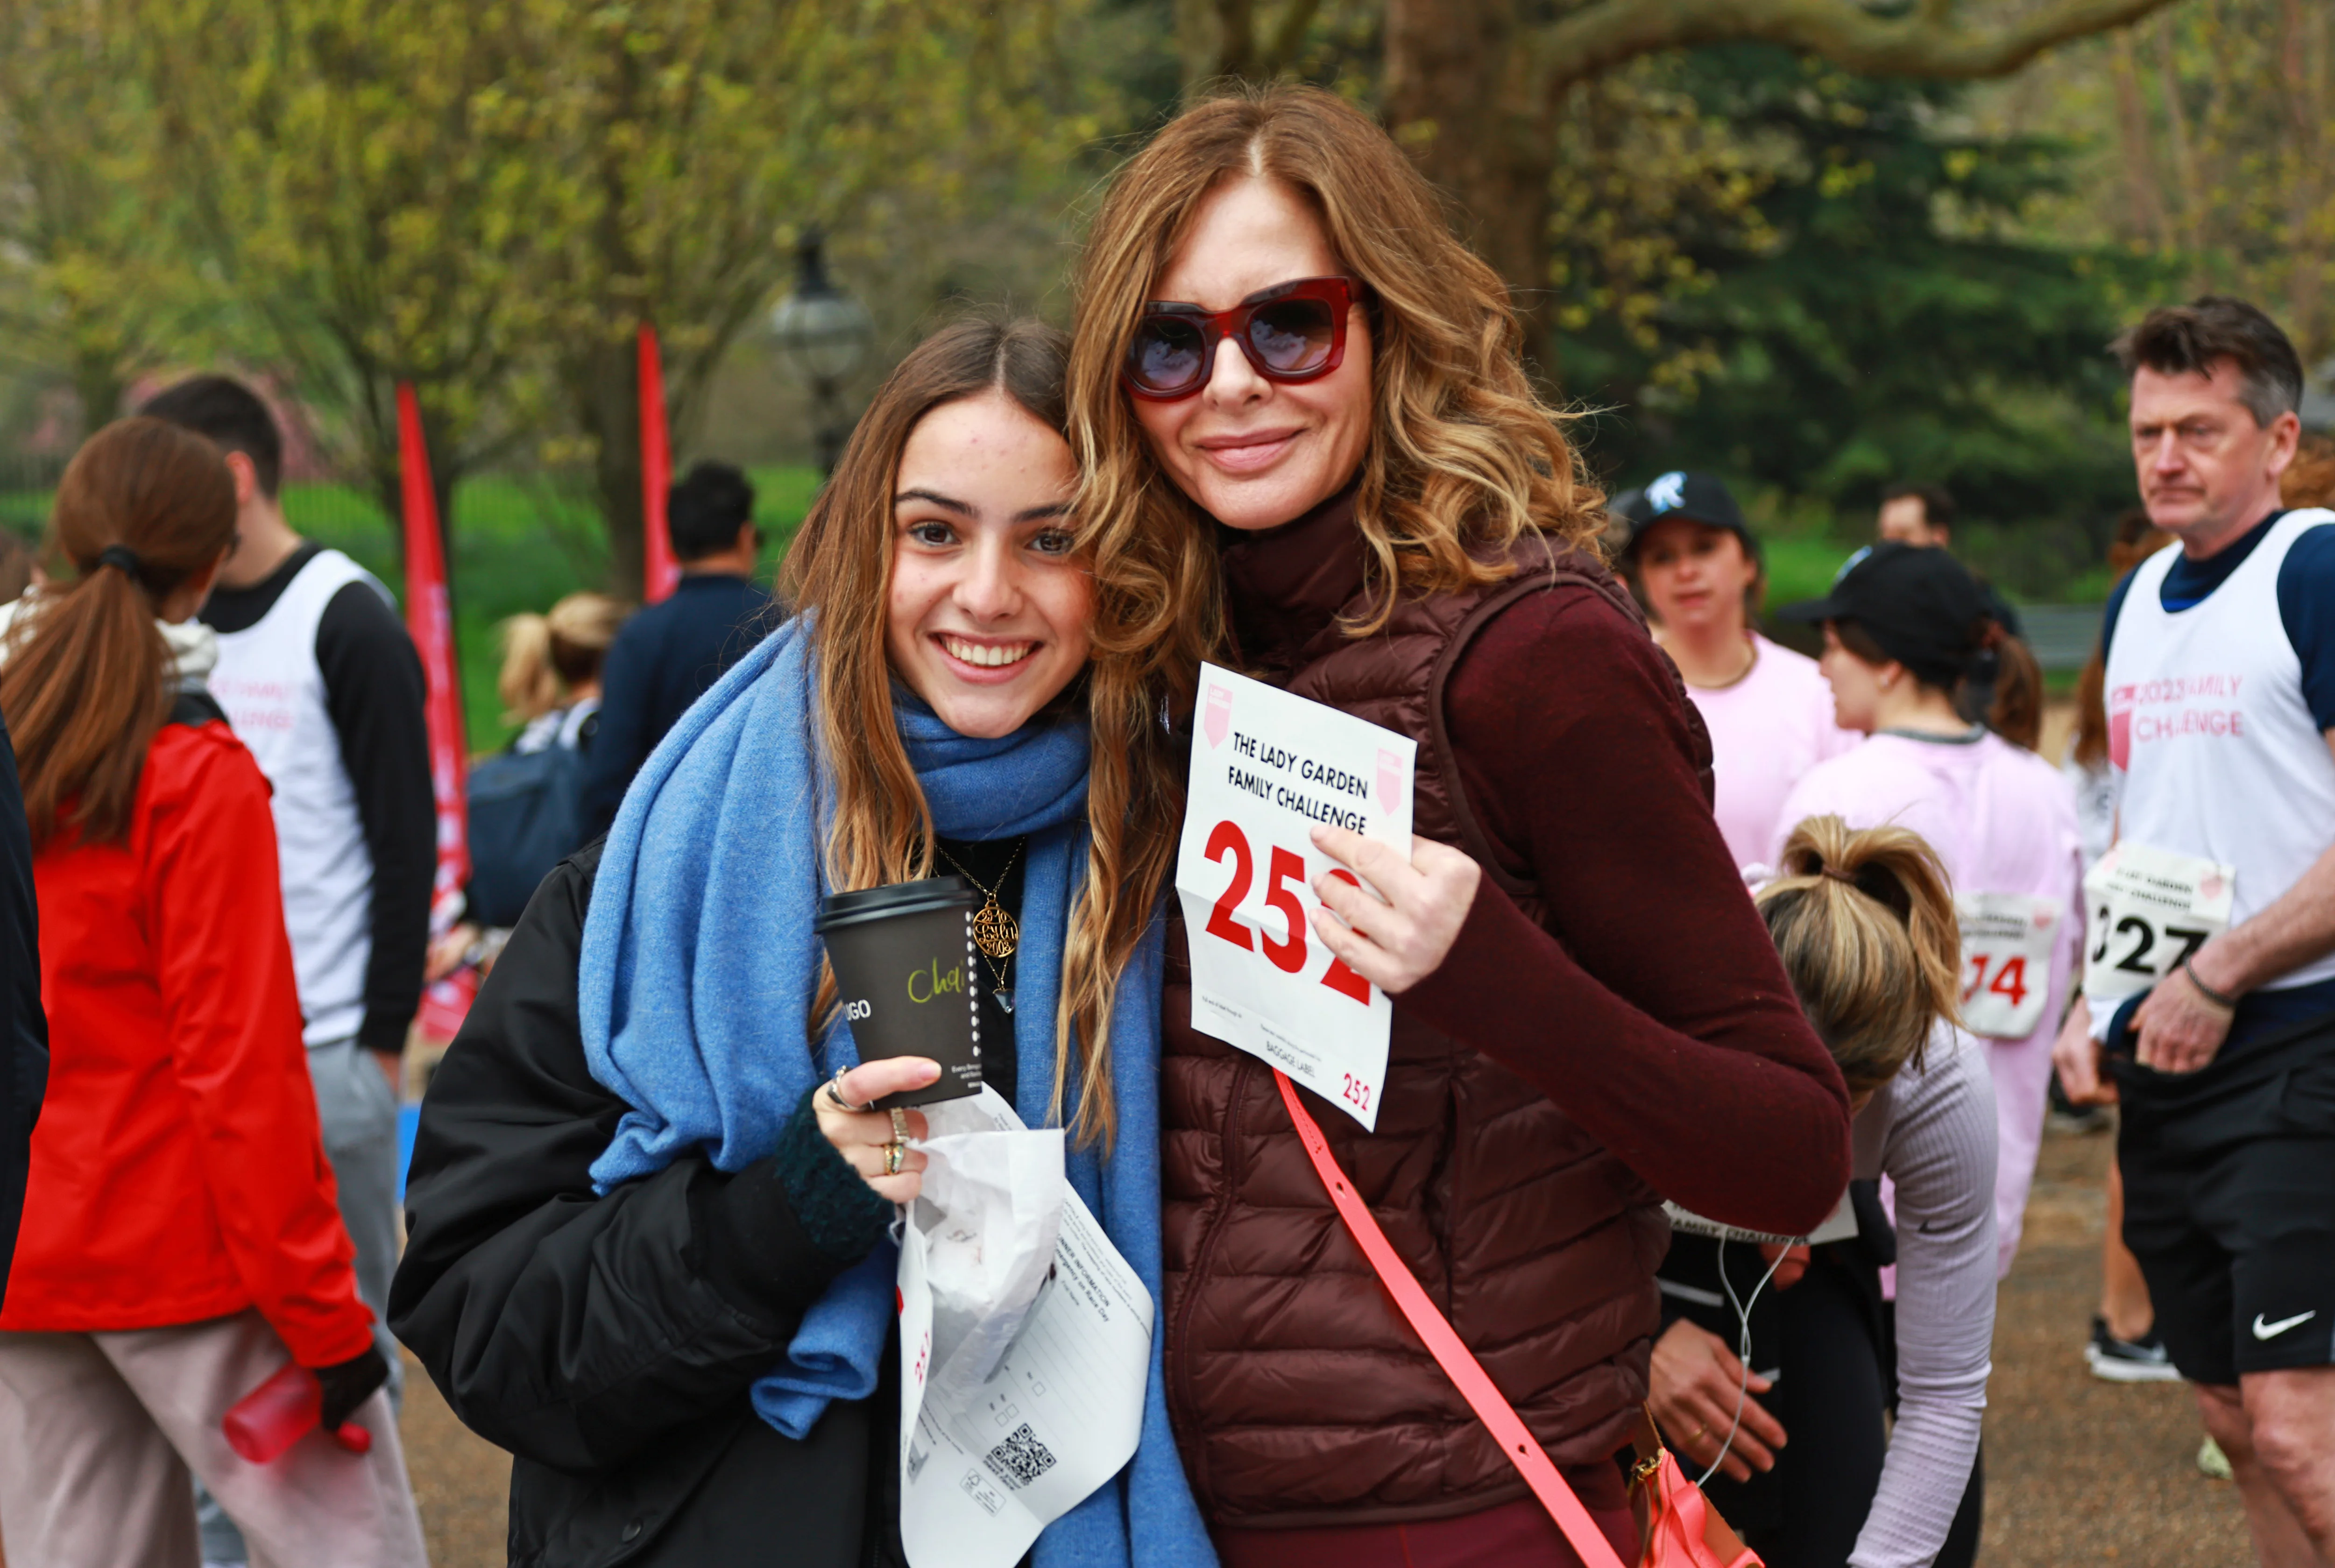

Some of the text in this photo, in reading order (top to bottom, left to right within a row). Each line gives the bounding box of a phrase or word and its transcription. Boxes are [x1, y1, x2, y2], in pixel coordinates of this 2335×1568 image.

[1234, 732, 1256, 757] THE
[1260, 743, 1297, 772] LADY
[1302, 759, 1368, 799] GARDEN
[1229, 766, 1366, 835] FAMILY CHALLENGE
[1266, 1040, 1296, 1067] BAGGAGE
[1297, 1059, 1316, 1078] LABEL
[1343, 1073, 1371, 1112] 252
[1075, 1257, 1110, 1307] INFORMATION
